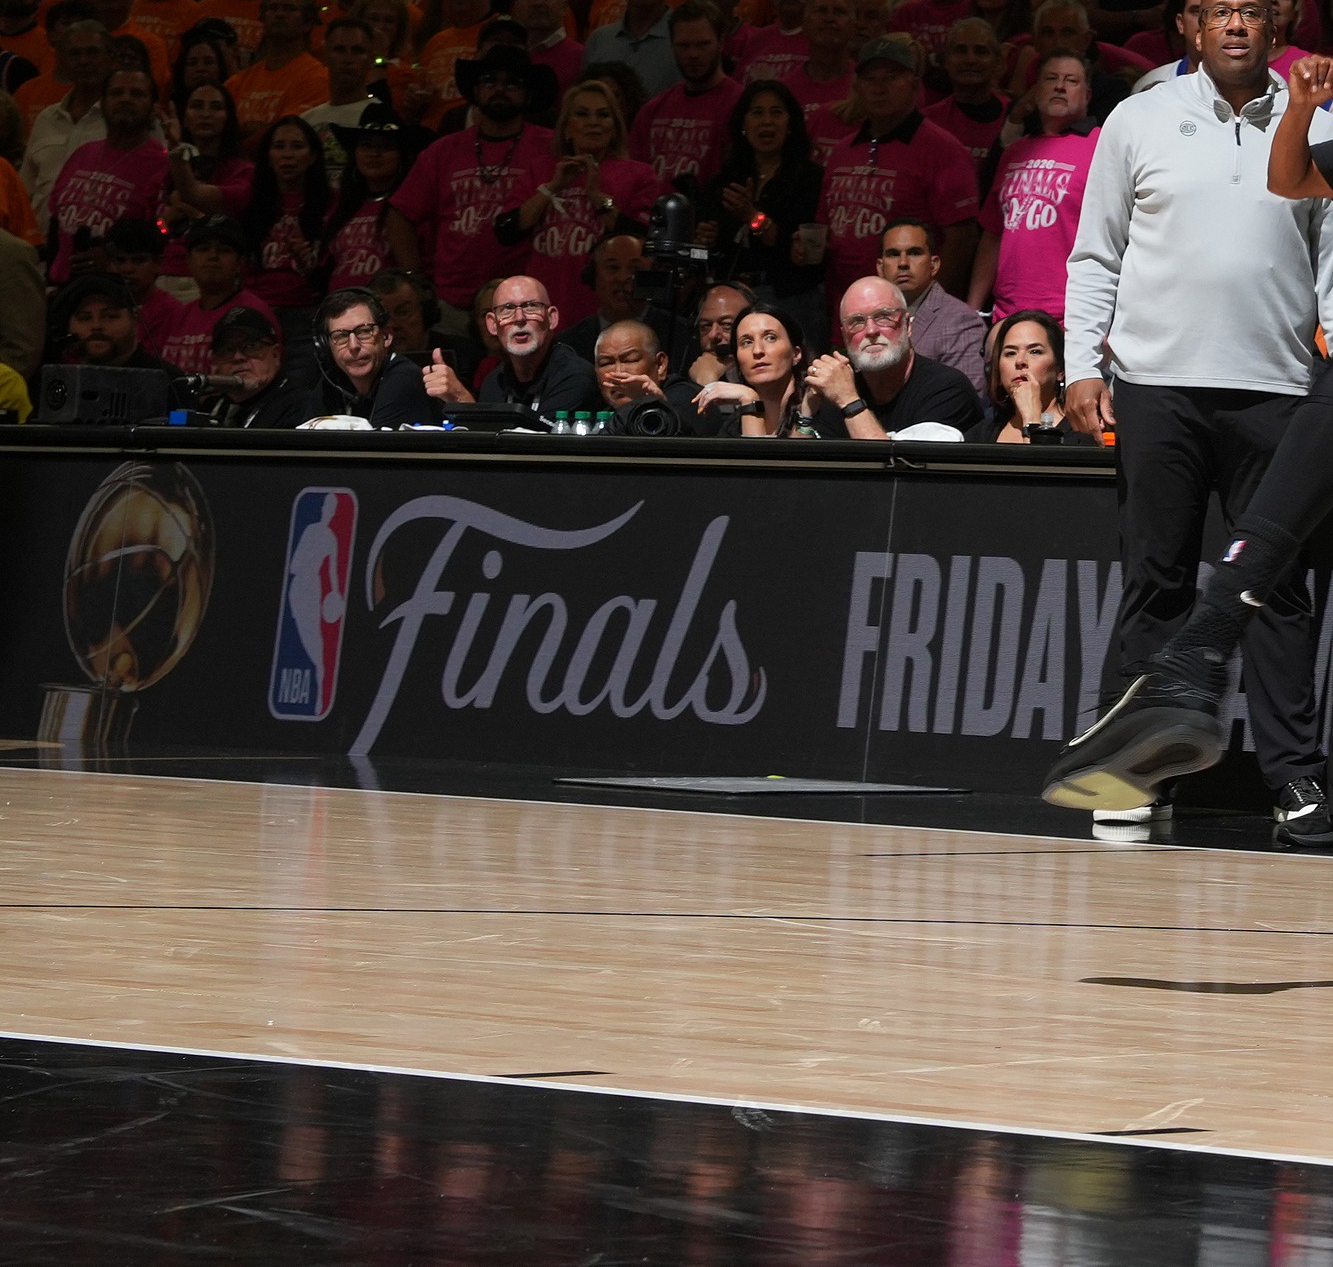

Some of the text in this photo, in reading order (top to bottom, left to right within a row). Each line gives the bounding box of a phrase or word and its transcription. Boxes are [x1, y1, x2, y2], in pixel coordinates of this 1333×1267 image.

[1026, 159, 1055, 170] 2026
[1001, 167, 1070, 204] FINALS
[855, 207, 886, 238] GO
[1026, 202, 1058, 230] GO
[348, 494, 768, 757] Finals
[836, 551, 1124, 741] FRIDAY
[279, 668, 310, 705] NBA
